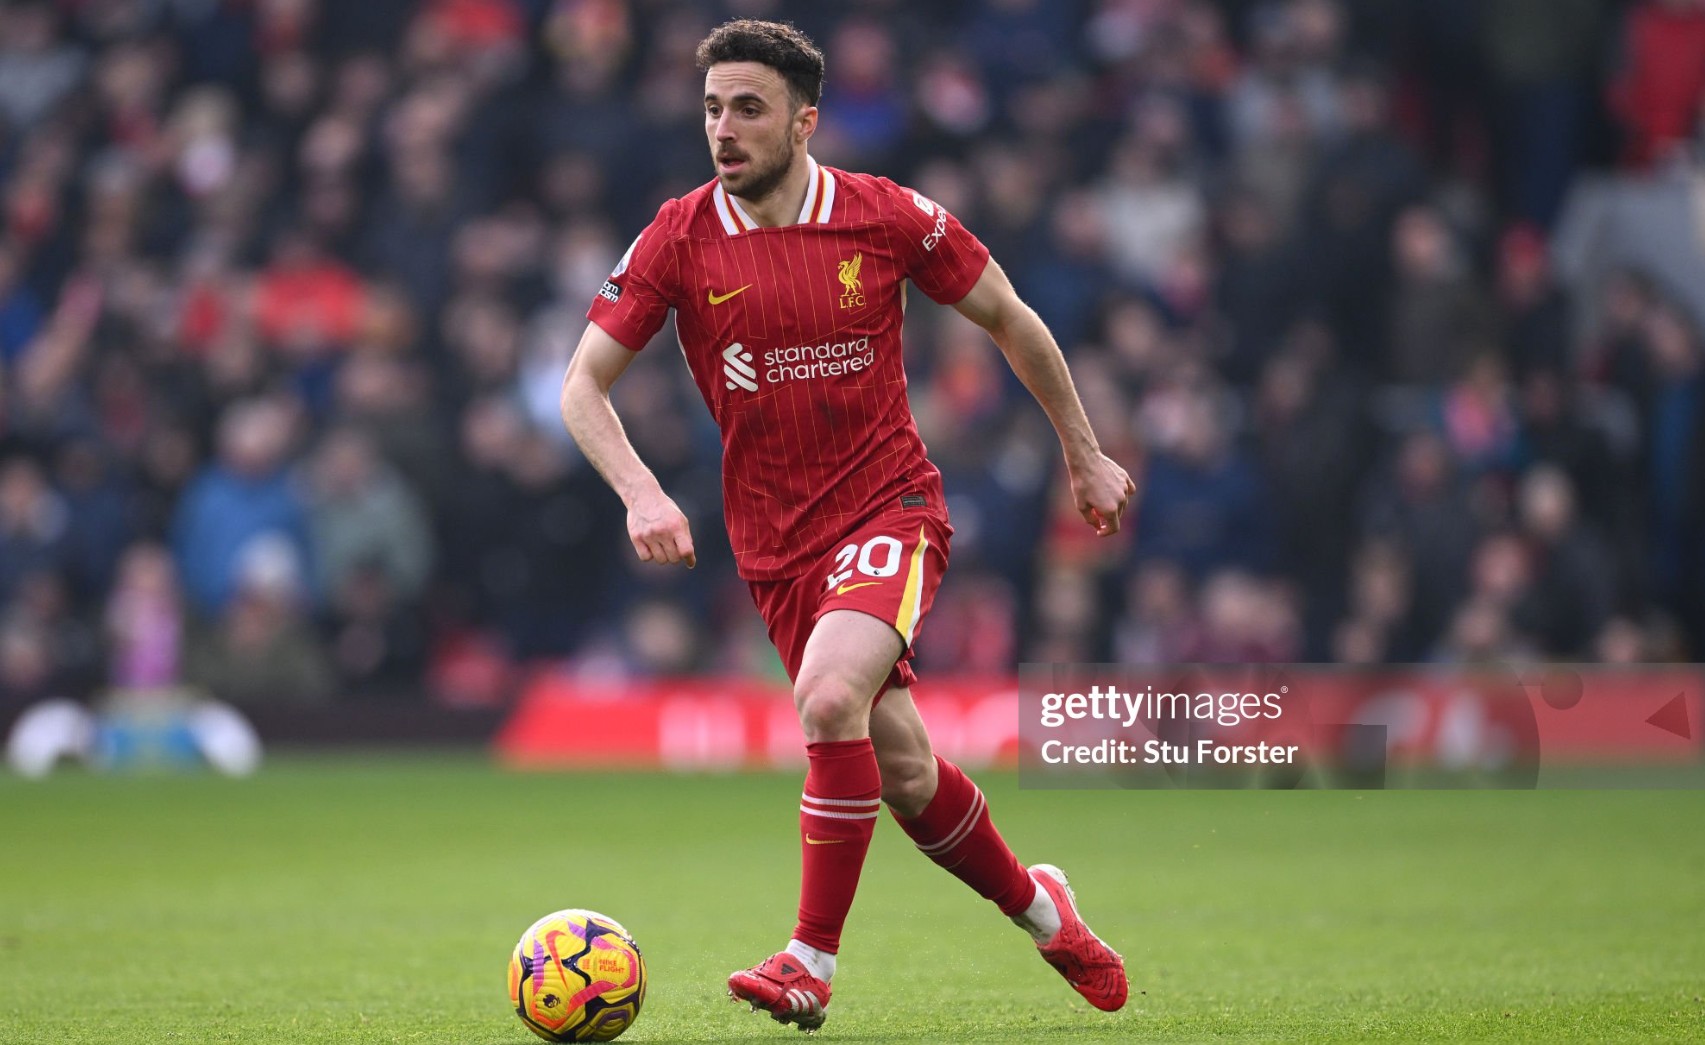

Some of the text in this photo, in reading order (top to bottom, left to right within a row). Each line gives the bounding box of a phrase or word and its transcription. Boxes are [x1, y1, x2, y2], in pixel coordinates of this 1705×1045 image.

[764, 336, 869, 366] standard
[766, 348, 874, 383] chartered
[827, 535, 903, 590] 20
[599, 965, 625, 974] FLIGHT
